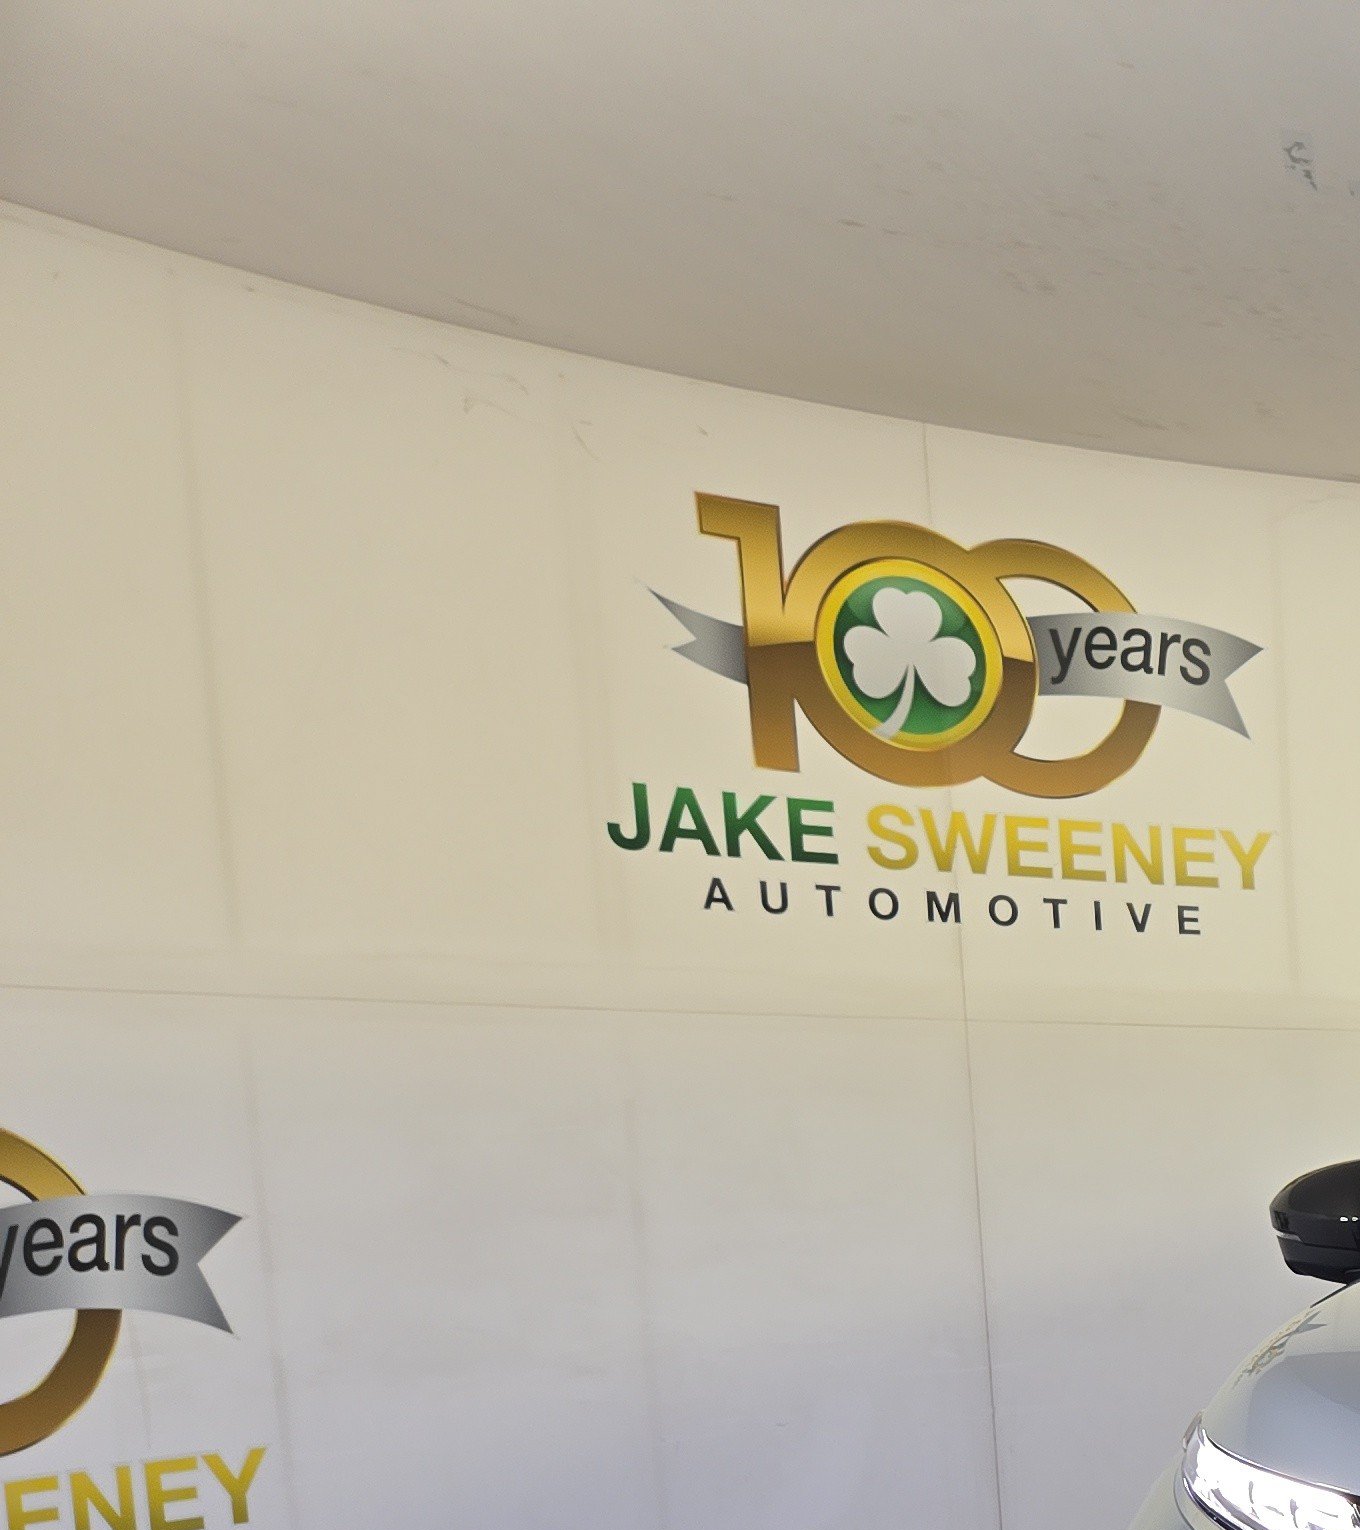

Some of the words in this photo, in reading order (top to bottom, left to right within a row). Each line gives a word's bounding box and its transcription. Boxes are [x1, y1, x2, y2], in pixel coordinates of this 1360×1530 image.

[1048, 623, 1212, 686] years
[606, 781, 840, 865] JAKE
[866, 803, 1273, 891] SWEENEY
[703, 876, 1203, 936] AUTOMOTIVE
